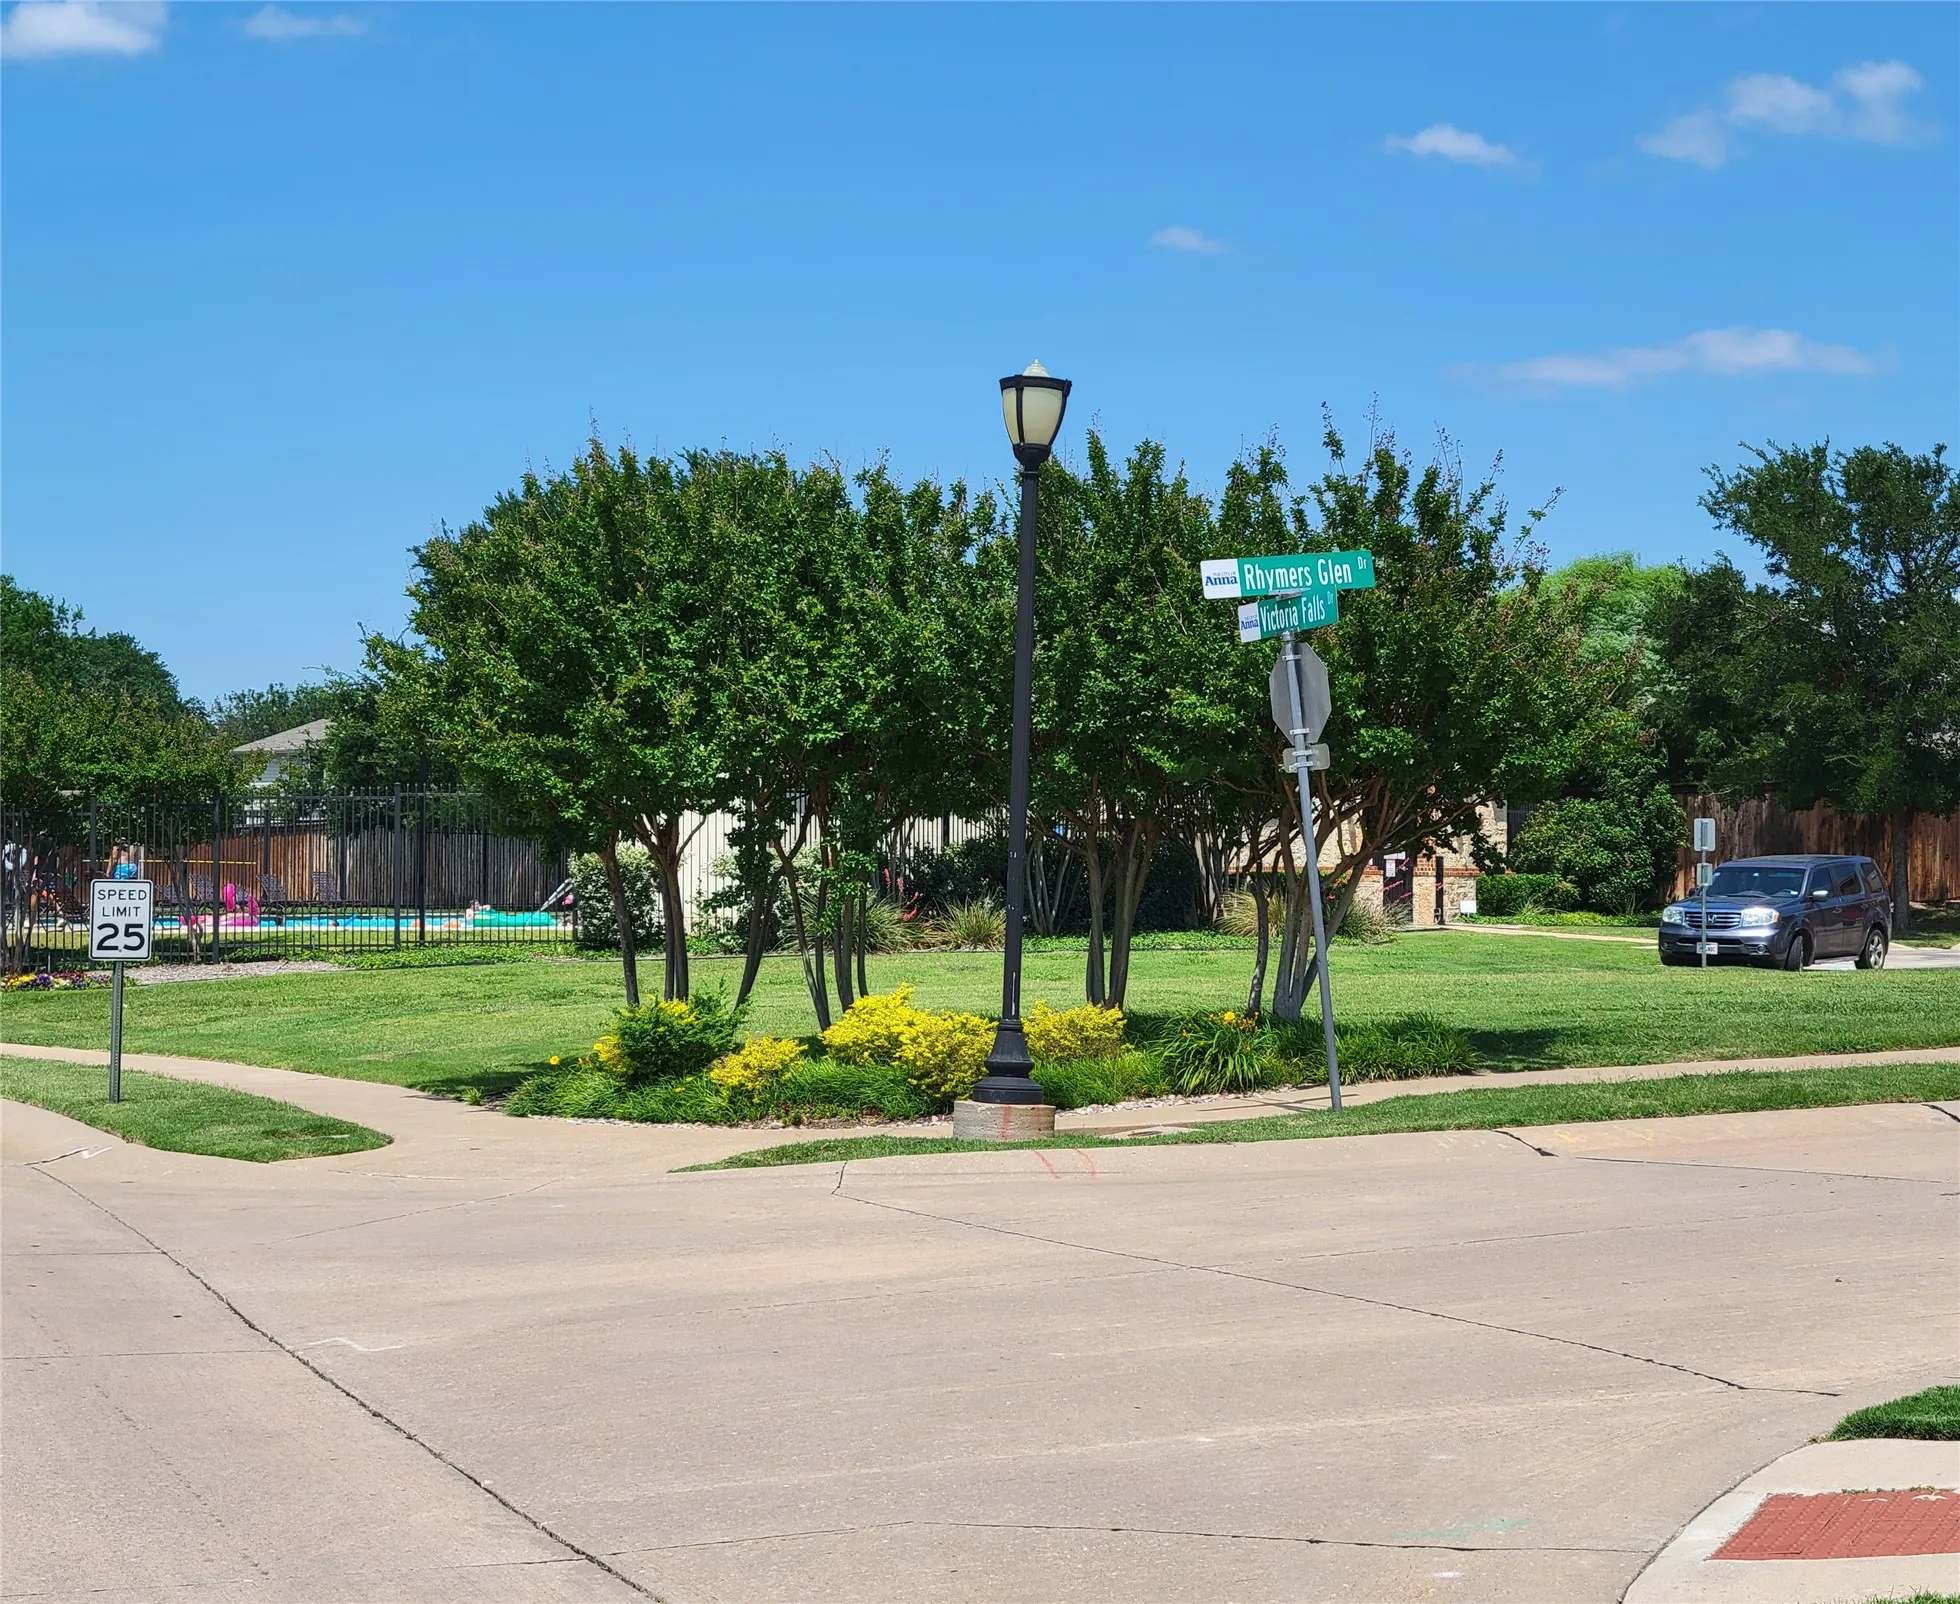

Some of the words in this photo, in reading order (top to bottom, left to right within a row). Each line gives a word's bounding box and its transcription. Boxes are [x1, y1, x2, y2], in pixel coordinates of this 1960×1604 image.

[1243, 563, 1313, 591] Rhymers
[1317, 558, 1352, 585] Glen
[1357, 556, 1367, 570] Dr
[1205, 575, 1238, 586] Anna
[1259, 601, 1299, 632] Victoria
[1301, 594, 1326, 624] Falls
[1327, 591, 1334, 605] Dr
[1240, 618, 1259, 630] Anna
[97, 889, 147, 901] SPEED
[102, 906, 141, 917] LIMIT
[96, 923, 145, 951] 25
